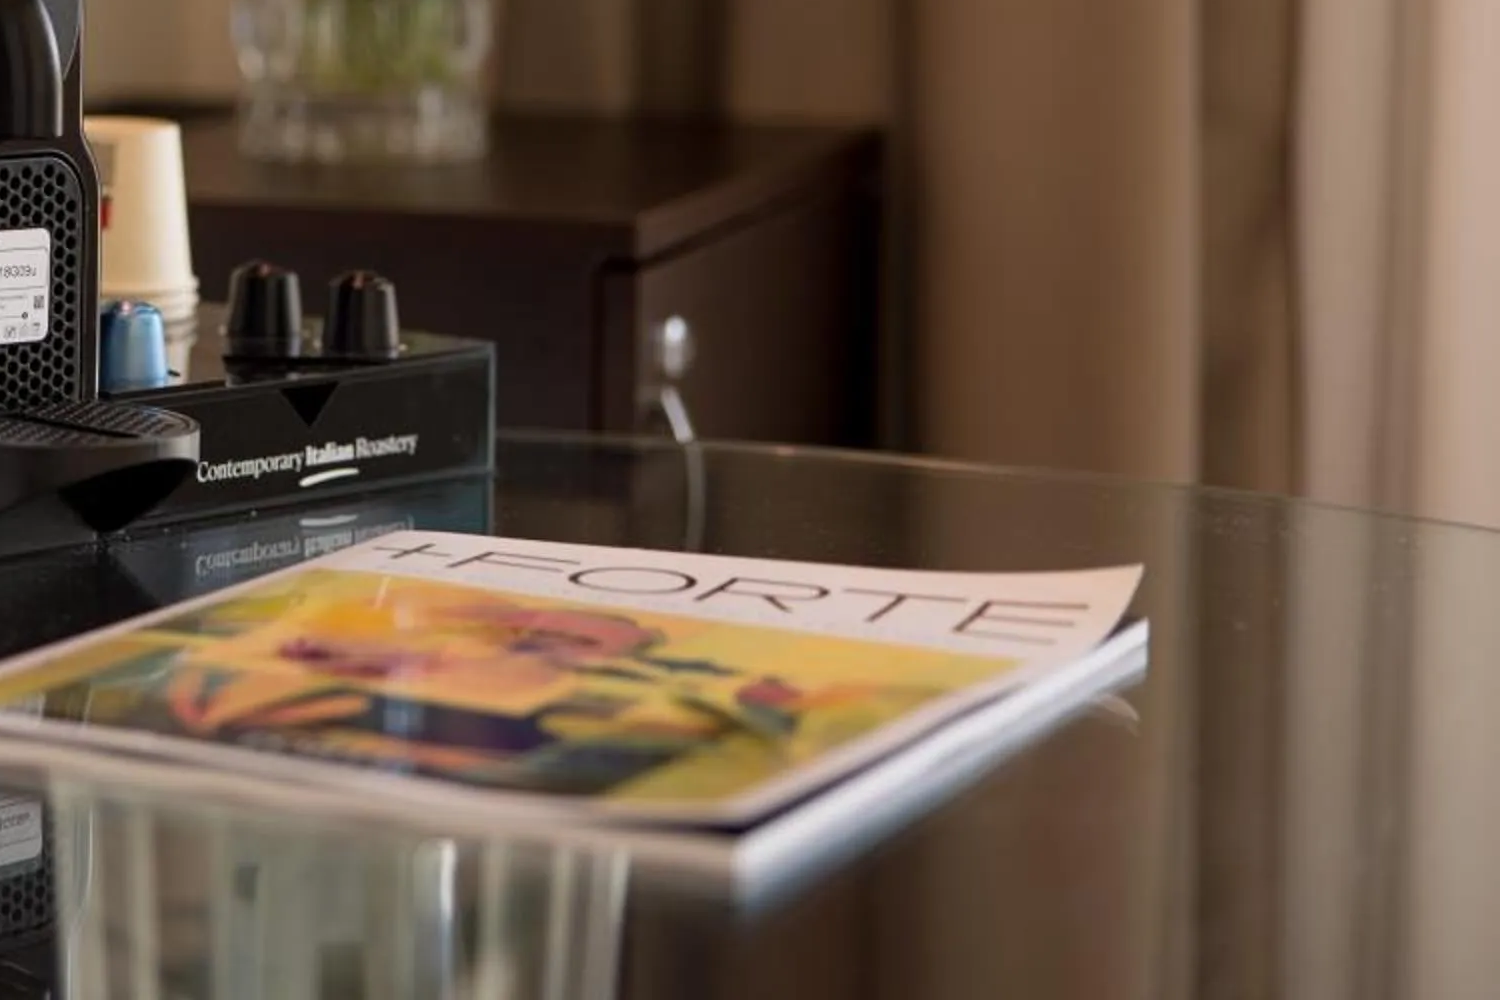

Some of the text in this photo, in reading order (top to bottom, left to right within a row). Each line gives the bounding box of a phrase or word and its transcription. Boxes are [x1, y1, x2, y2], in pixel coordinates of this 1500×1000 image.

[196, 433, 419, 483] Contemporary Italian Roastery
